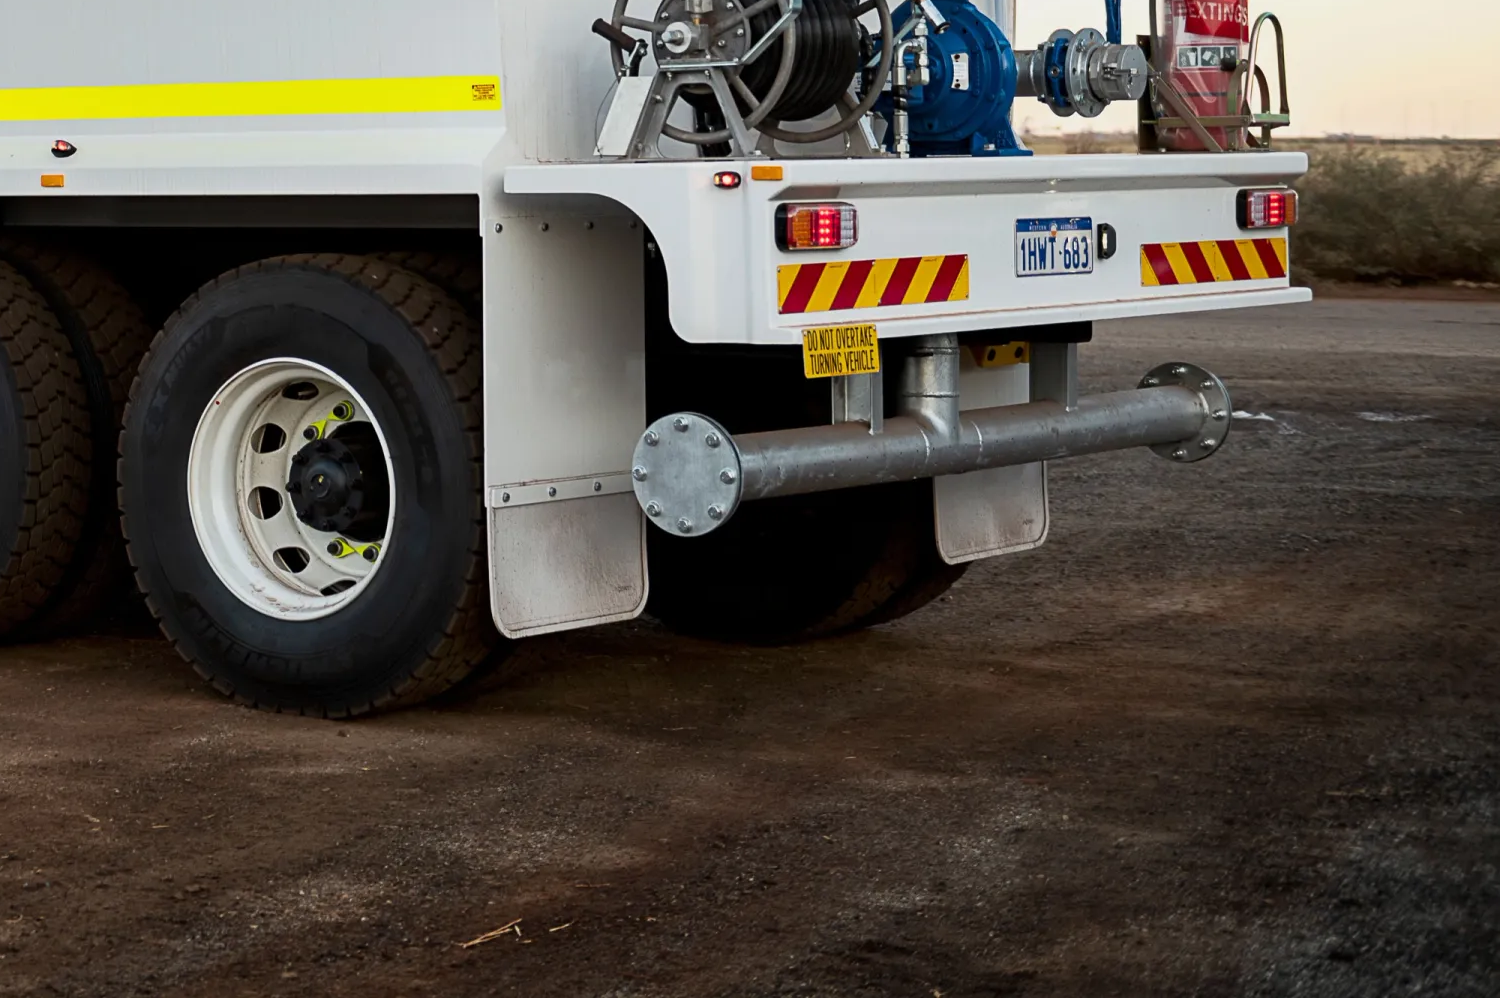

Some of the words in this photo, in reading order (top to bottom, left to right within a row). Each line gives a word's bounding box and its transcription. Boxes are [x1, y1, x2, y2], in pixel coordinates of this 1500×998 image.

[807, 330, 818, 351] DO
[819, 329, 834, 351] NOT
[836, 326, 874, 349] OVERTAKE
[810, 352, 842, 375] TURNING
[844, 349, 875, 372] VEHICLE
